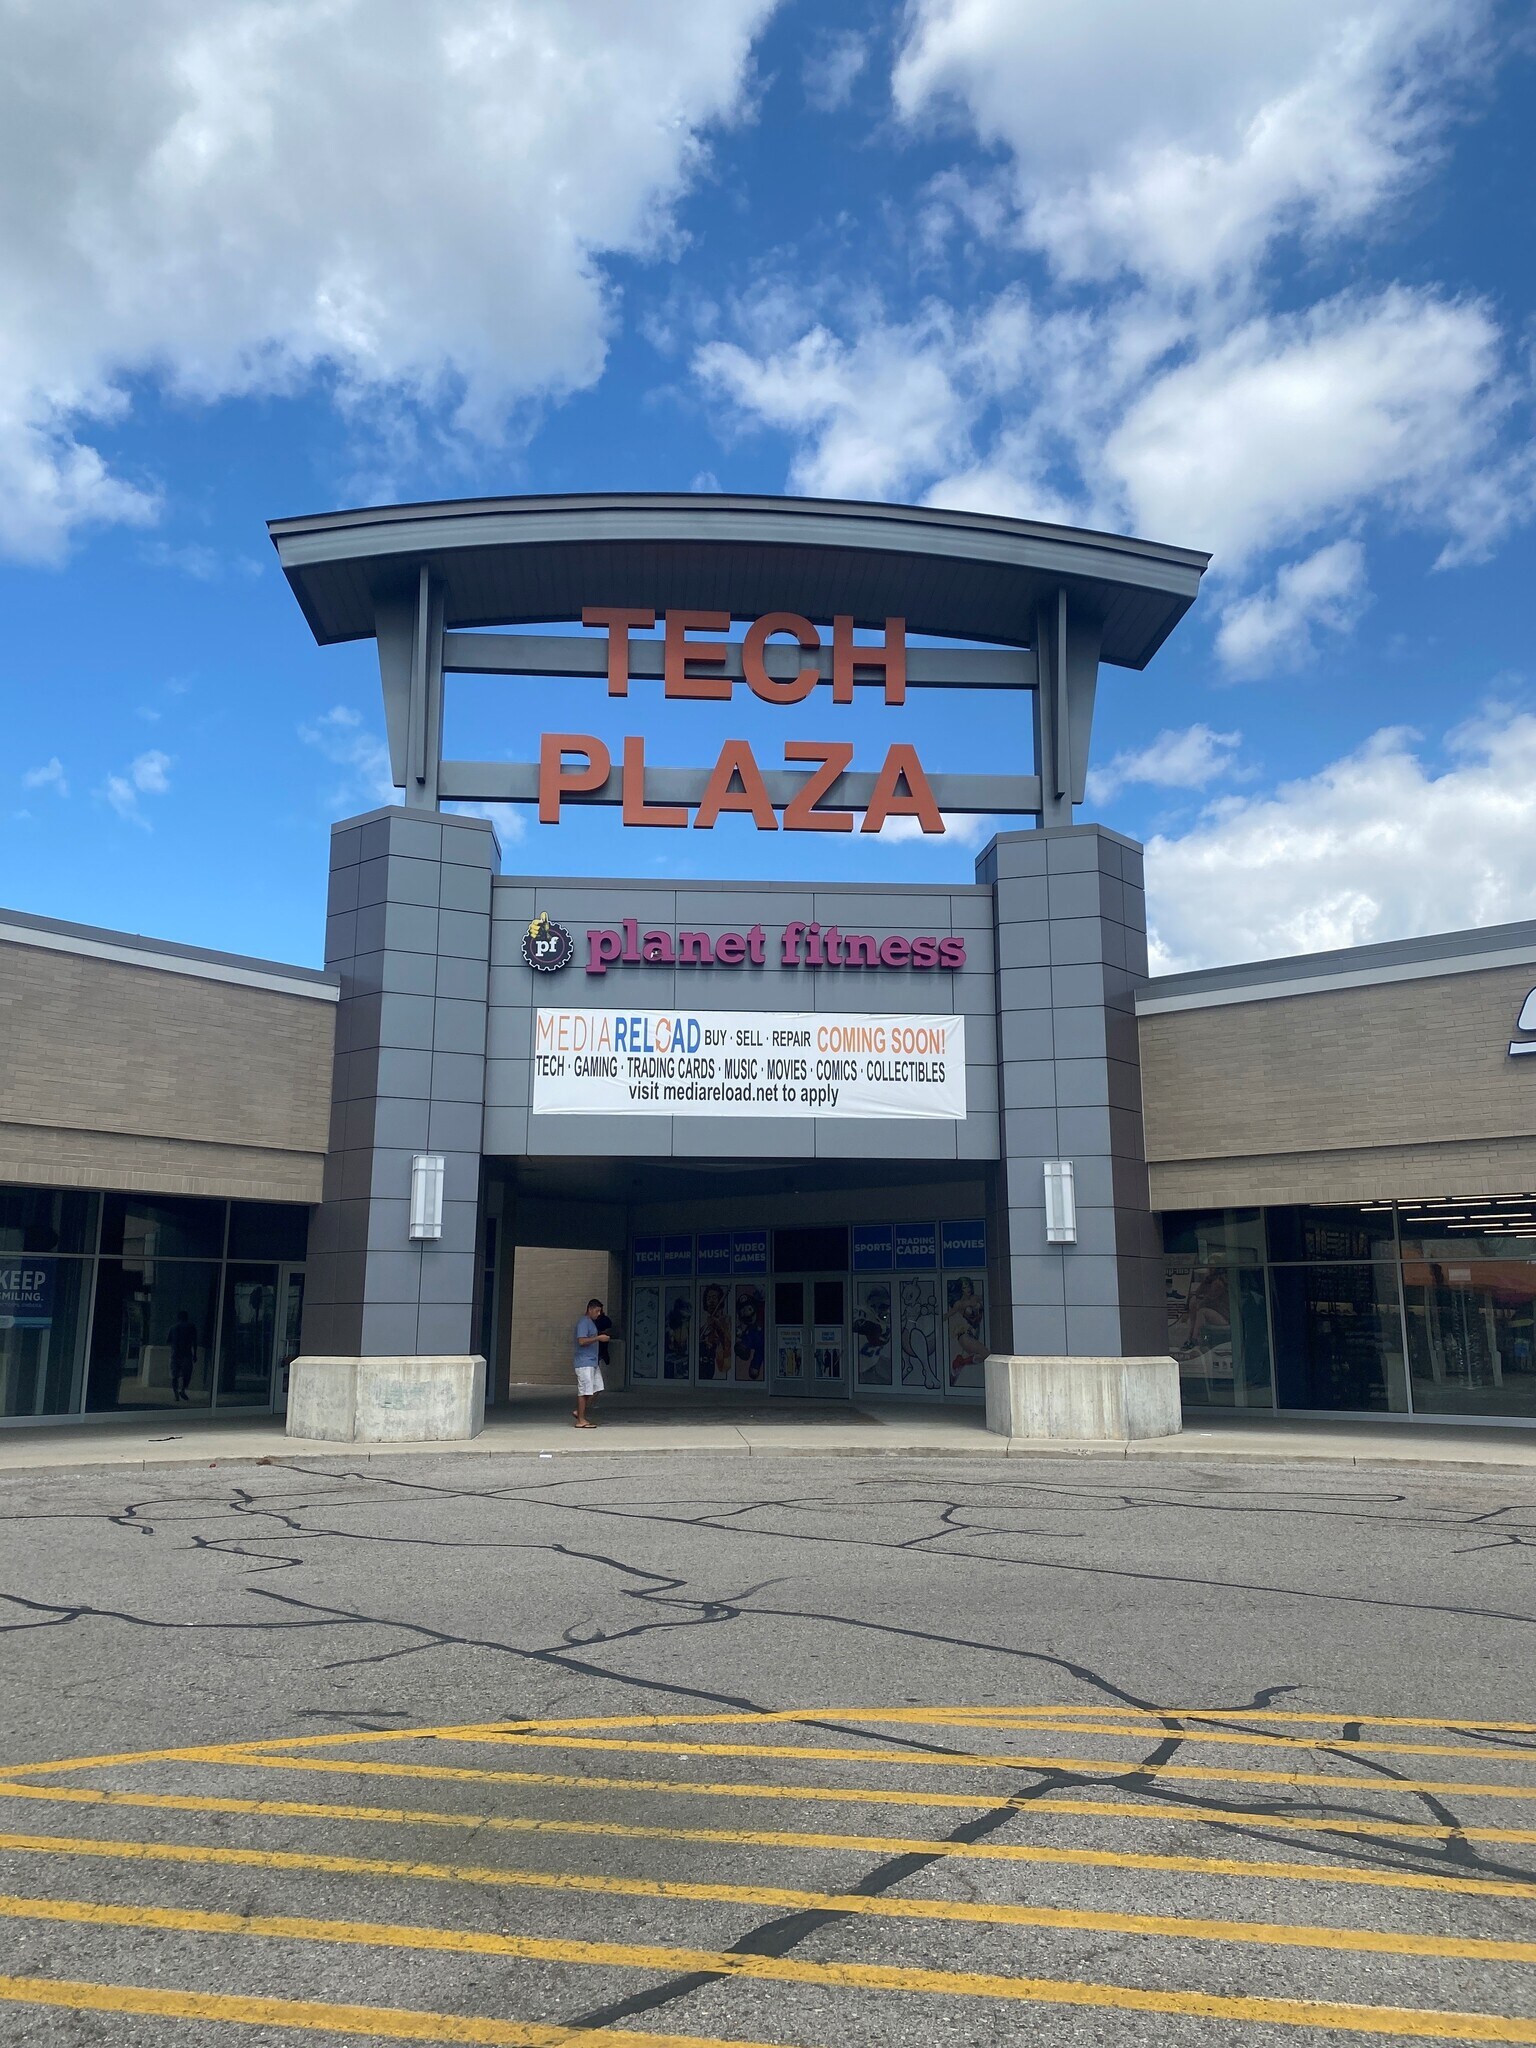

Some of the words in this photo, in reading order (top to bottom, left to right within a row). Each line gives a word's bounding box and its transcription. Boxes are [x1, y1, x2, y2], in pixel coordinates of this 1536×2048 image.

[582, 606, 906, 706] TECH
[539, 733, 946, 834] PLAZA
[535, 936, 559, 957] pf
[585, 918, 766, 974] planet
[781, 921, 967, 968] fitness
[704, 1029, 727, 1046] BUY
[736, 1030, 763, 1047] SELL
[772, 1030, 811, 1047] REPAIR
[817, 1026, 886, 1054] COMING
[891, 1028, 946, 1055] SOON!
[536, 1055, 564, 1077] TECH
[574, 1056, 618, 1077] GAMING
[627, 1057, 675, 1078] TRADING
[678, 1058, 715, 1079] CARDS
[724, 1058, 758, 1080] MUSIC
[767, 1059, 807, 1080] MOVIES
[816, 1059, 858, 1081] COMICS
[866, 1061, 946, 1083] COLLECTIBLES
[629, 1081, 659, 1100] visit
[663, 1082, 778, 1102] mediareload.net
[782, 1084, 797, 1102] to
[800, 1084, 839, 1107] apply
[896, 1237, 935, 1245] TRADING
[943, 1239, 985, 1249] MOVIES
[698, 1249, 730, 1258] MUSIC
[735, 1243, 766, 1252] VIDEO
[854, 1243, 892, 1252] SPORTS
[896, 1245, 936, 1255] CARDS
[635, 1251, 661, 1262] TECH
[664, 1250, 691, 1260] REPAIR
[735, 1253, 766, 1263] GAMES
[0, 1270, 46, 1290] KEEP
[0, 1292, 44, 1301] MILING.
